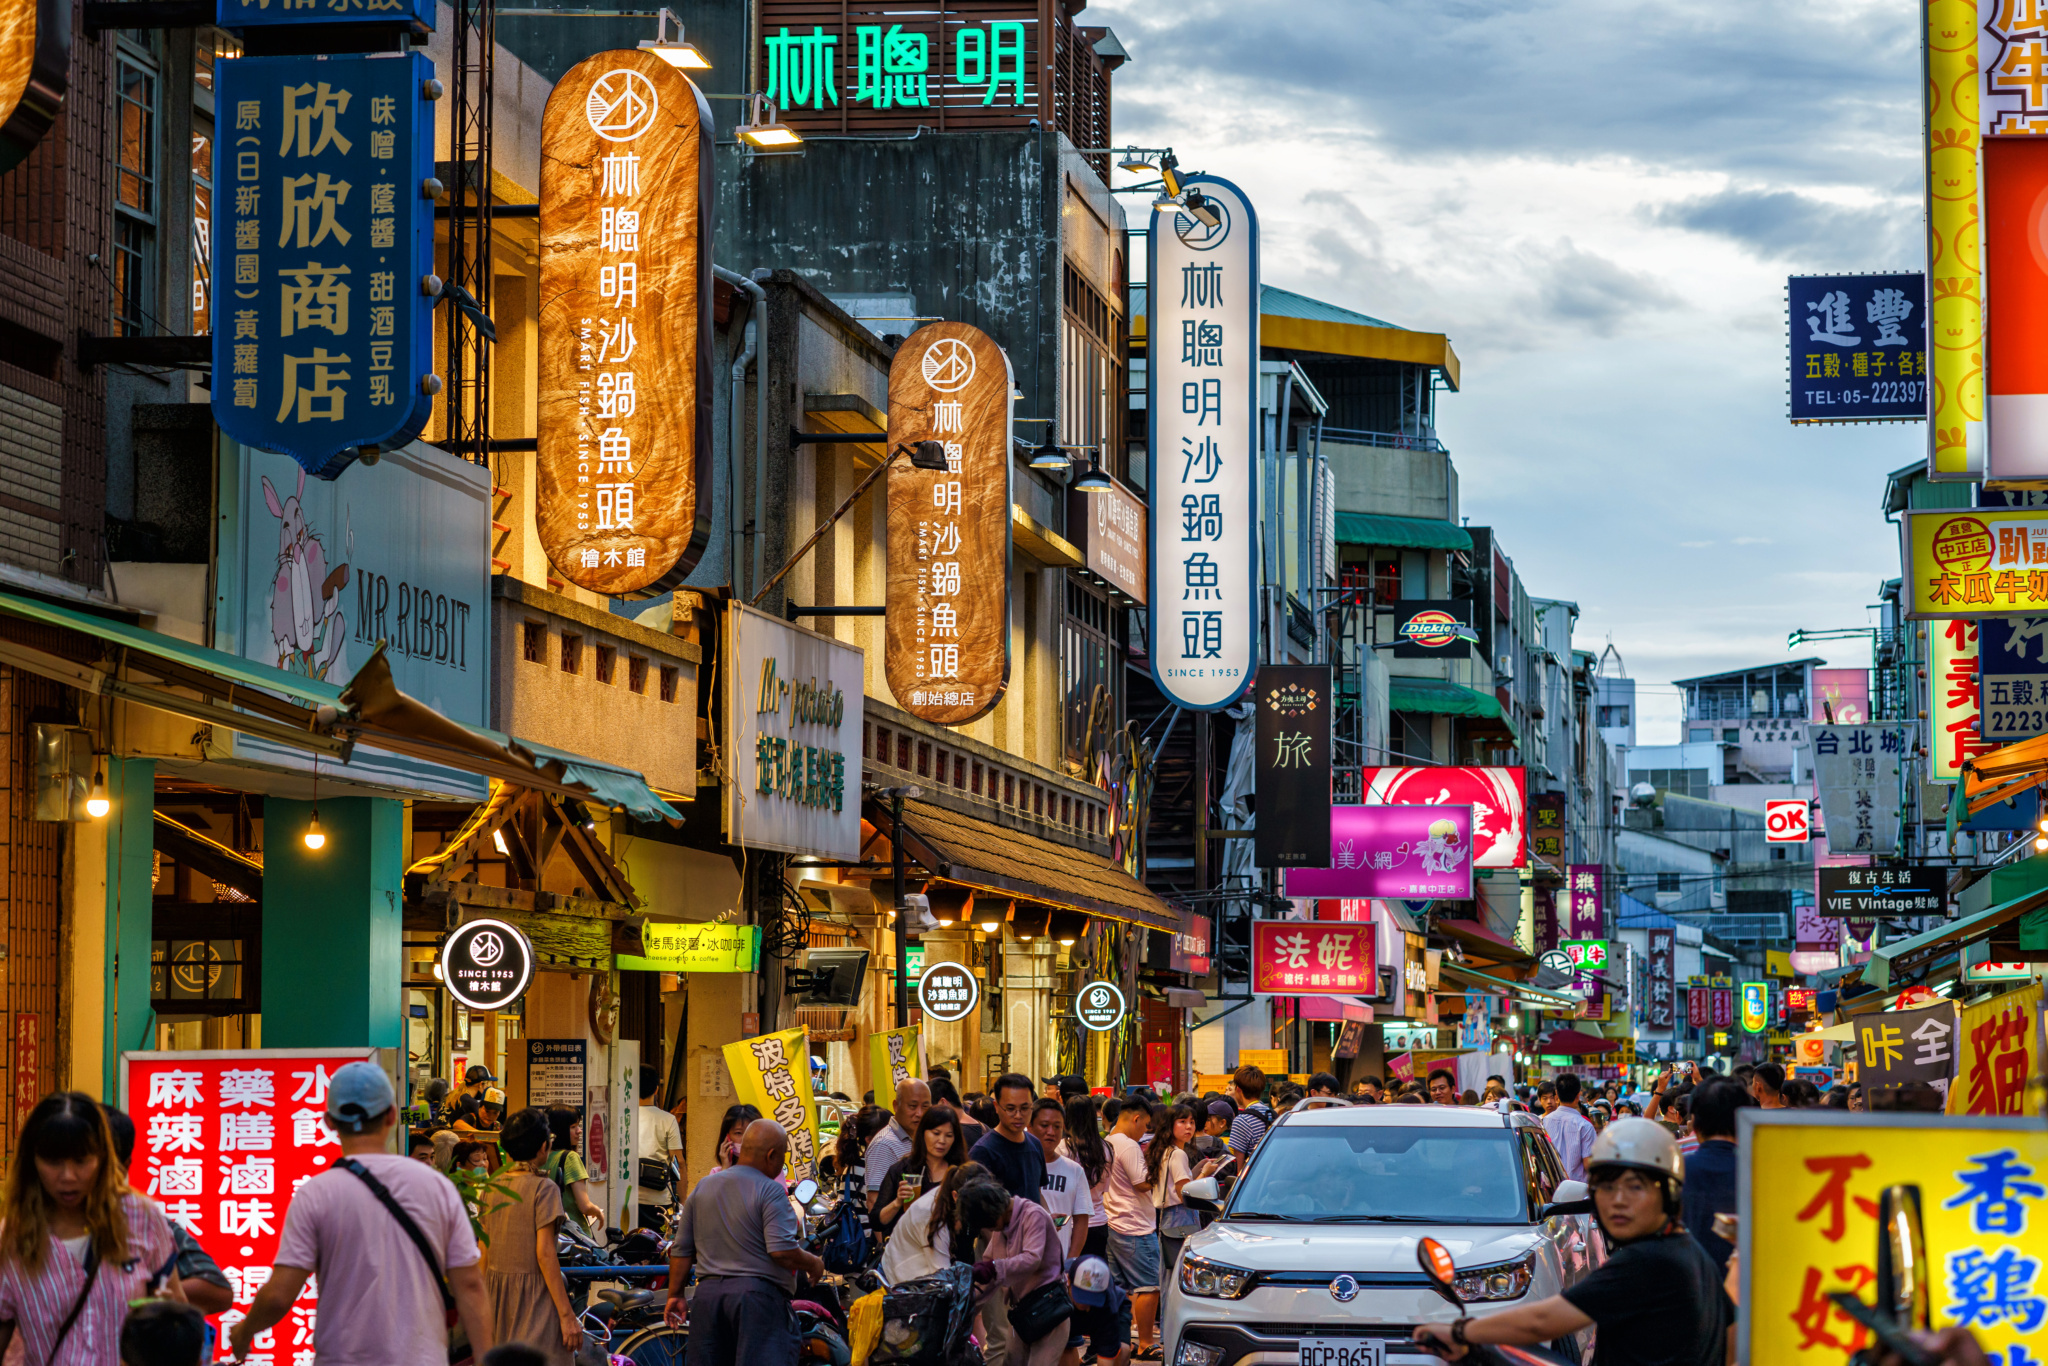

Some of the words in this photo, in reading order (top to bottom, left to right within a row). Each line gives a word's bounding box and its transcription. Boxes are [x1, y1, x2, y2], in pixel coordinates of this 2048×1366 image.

[765, 22, 1026, 110] 林聰明
[275, 81, 353, 424] 欣欣商店
[1806, 288, 1926, 347] 進豐
[580, 318, 592, 371] SMART
[596, 151, 641, 529] 林聰明沙鍋魚頭
[579, 381, 591, 416] FISH
[578, 434, 590, 483] SINCE
[1181, 261, 1224, 659] 林聰明沙鍋魚頭
[577, 493, 589, 530] 1953
[1949, 522, 1973, 536] 直營
[918, 521, 928, 561] SMART
[929, 399, 964, 678] 林聰明沙鍋魚頭
[1940, 538, 1987, 558] 中正店
[580, 547, 646, 568] 檜木館
[917, 564, 927, 595] FISH
[1929, 570, 2048, 605] 木瓜牛奶
[916, 606, 926, 647] SINCE
[1406, 624, 1456, 633] Dickie
[915, 650, 925, 678] 1953
[1167, 668, 1204, 678] SINCE
[1211, 668, 1240, 678] 1953
[911, 690, 975, 706] 創始總店
[1272, 731, 1312, 769] 旅
[1815, 729, 1906, 755] 台北城
[1768, 809, 1807, 833] OK
[1409, 885, 1456, 894] 嘉義中正店
[1848, 871, 1911, 884] 復古生活
[1827, 898, 1852, 910] VIE
[1858, 898, 1913, 911] Vintage
[1275, 931, 1354, 971] 法妮
[1566, 944, 1606, 965] 犀牛
[458, 970, 490, 978] SINCE
[491, 970, 514, 978] 1953
[469, 981, 501, 992] 檜木館
[1966, 1005, 2029, 1116] 貓
[147, 1069, 204, 1237] 麻辣滷味
